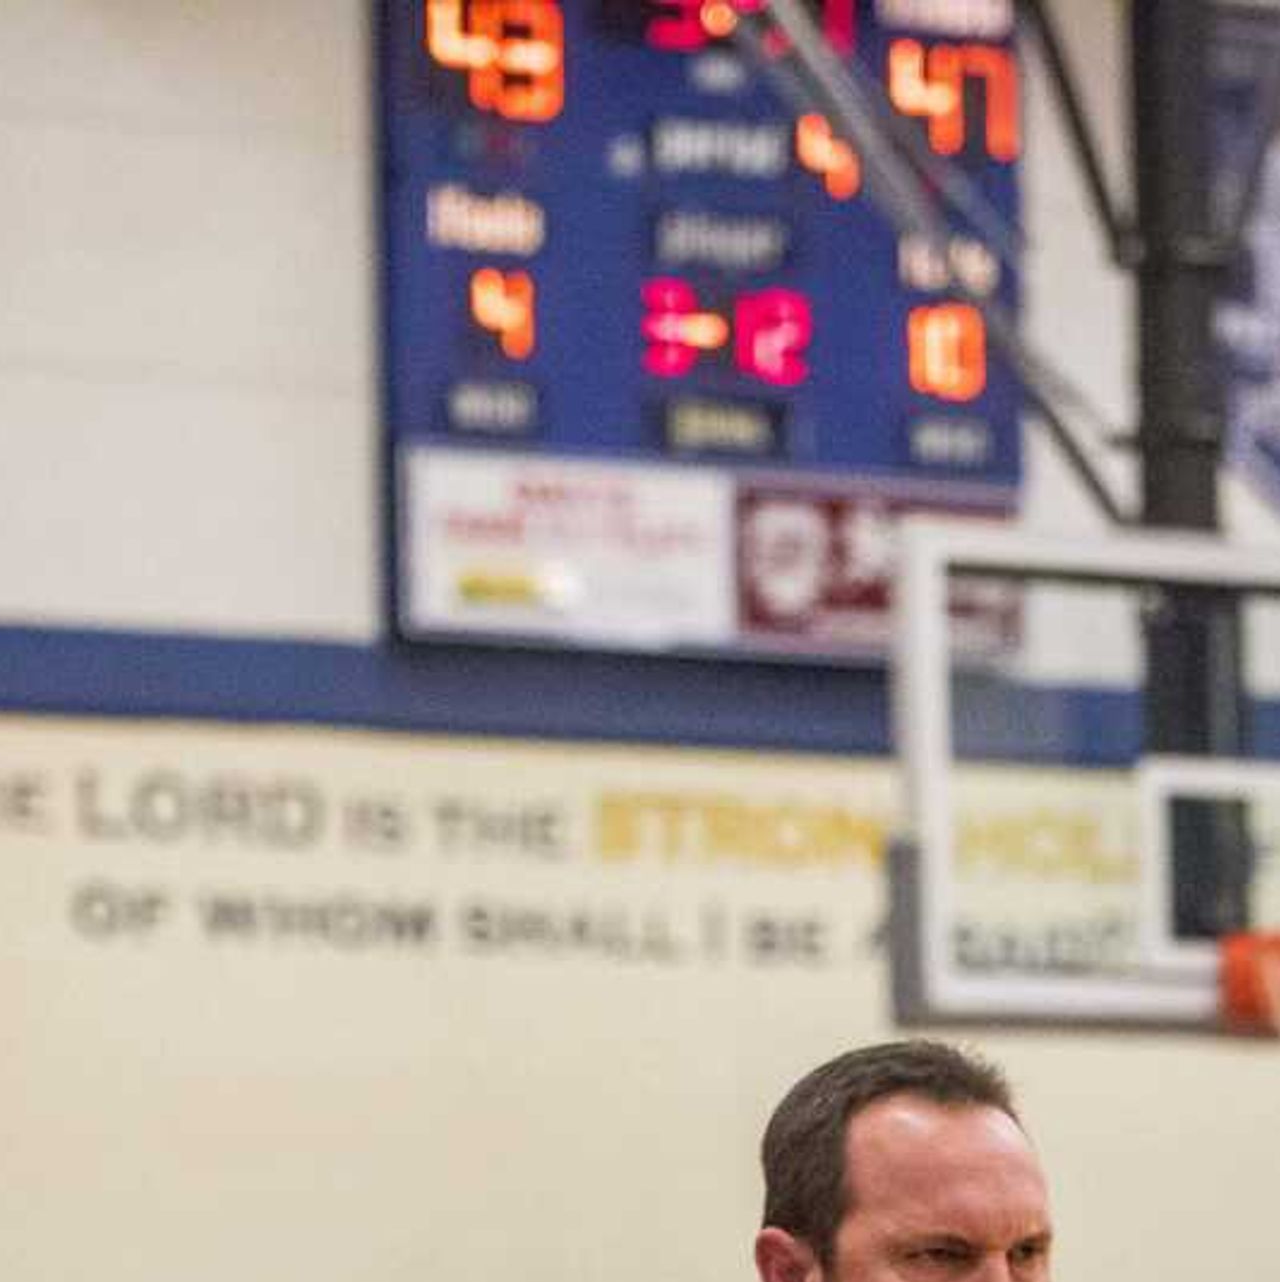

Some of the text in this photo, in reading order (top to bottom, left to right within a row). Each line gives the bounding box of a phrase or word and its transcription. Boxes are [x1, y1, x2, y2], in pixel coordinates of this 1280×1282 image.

[74, 762, 326, 850] LORD
[202, 890, 438, 950] WHOM
[462, 900, 677, 962] SHALL
[748, 915, 826, 962] BE
